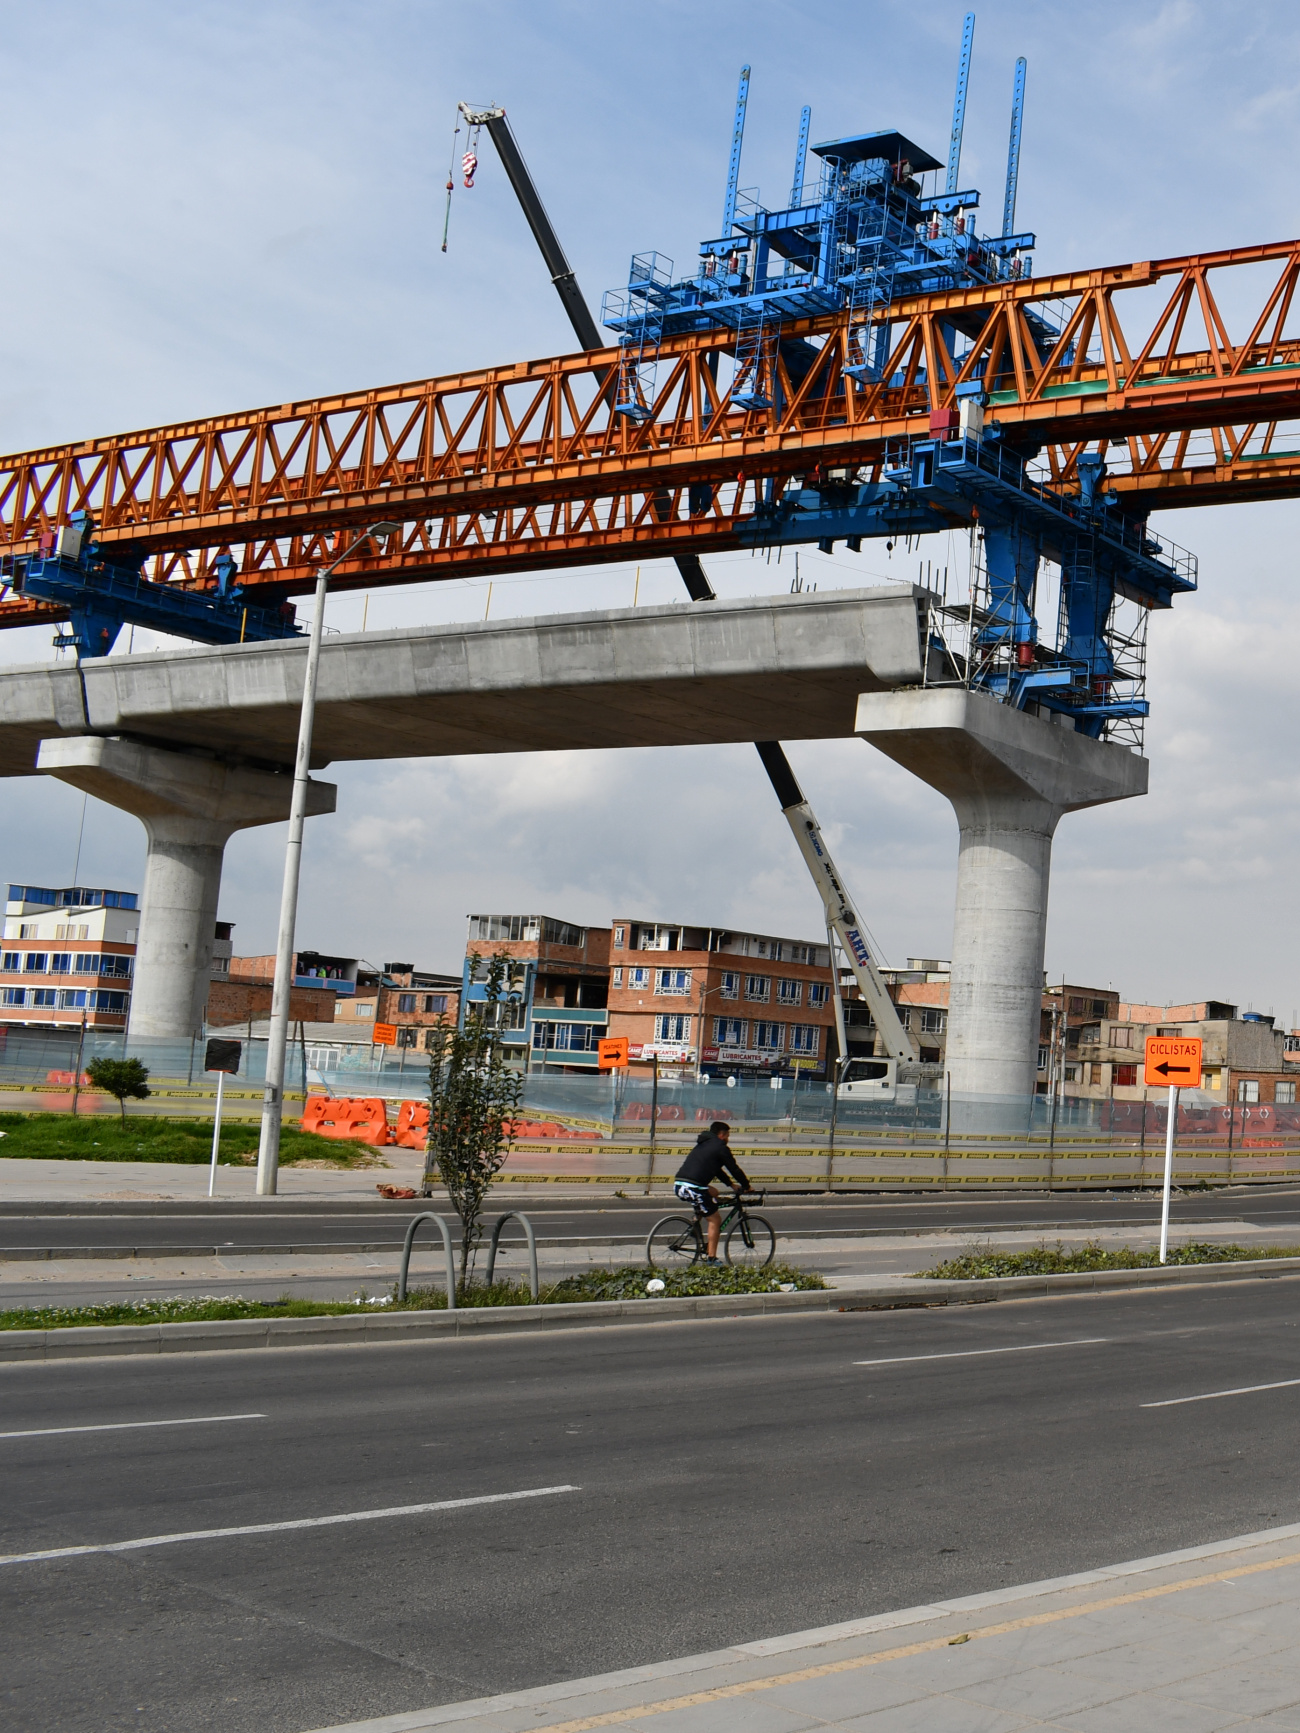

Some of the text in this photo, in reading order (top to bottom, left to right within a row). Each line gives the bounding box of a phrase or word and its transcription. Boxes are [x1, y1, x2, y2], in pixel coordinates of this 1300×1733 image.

[811, 839, 823, 857] XCMG
[848, 930, 870, 961] AHT
[722, 1052, 762, 1061] LUBRICANTES
[1150, 1044, 1197, 1056] CICLISTAS
